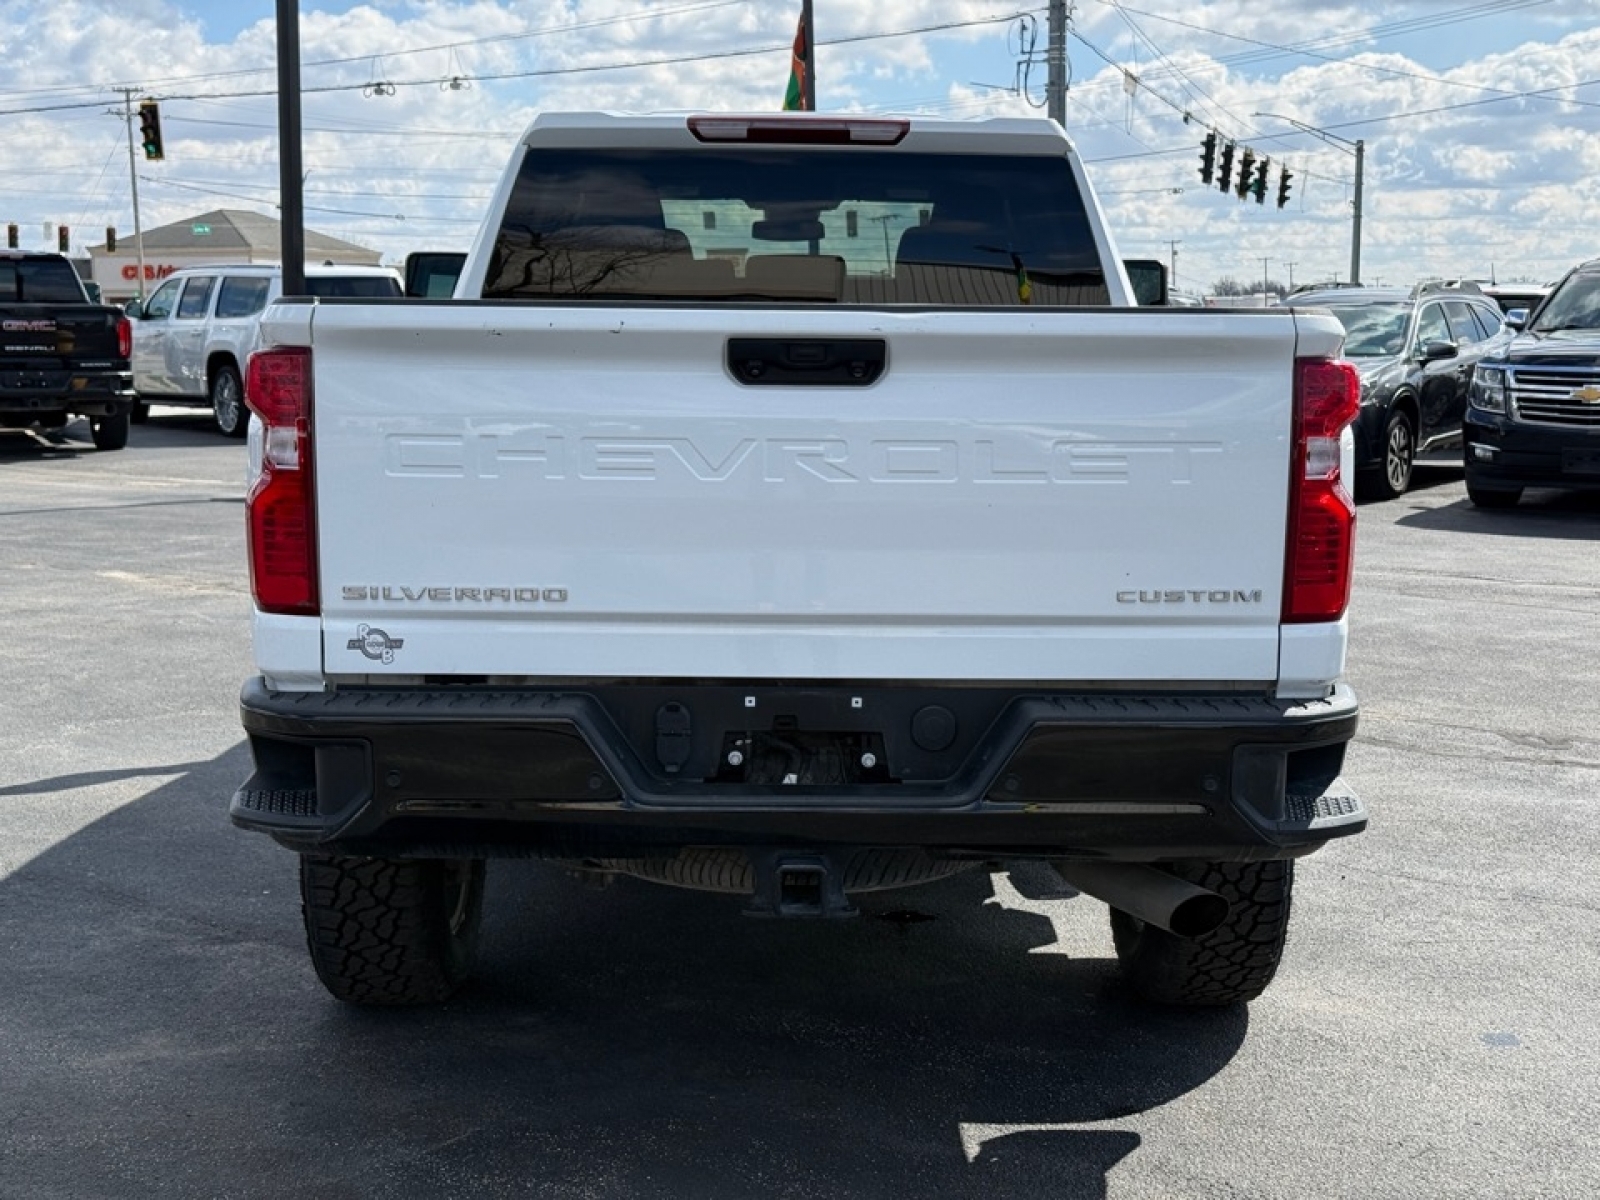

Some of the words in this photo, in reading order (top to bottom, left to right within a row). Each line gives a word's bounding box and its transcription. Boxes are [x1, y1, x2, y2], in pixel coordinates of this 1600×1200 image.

[3, 319, 57, 330] GMC
[384, 432, 1223, 485] CHEVROLET
[342, 585, 568, 603] SILVERADO
[1116, 589, 1263, 603] CUSTOM
